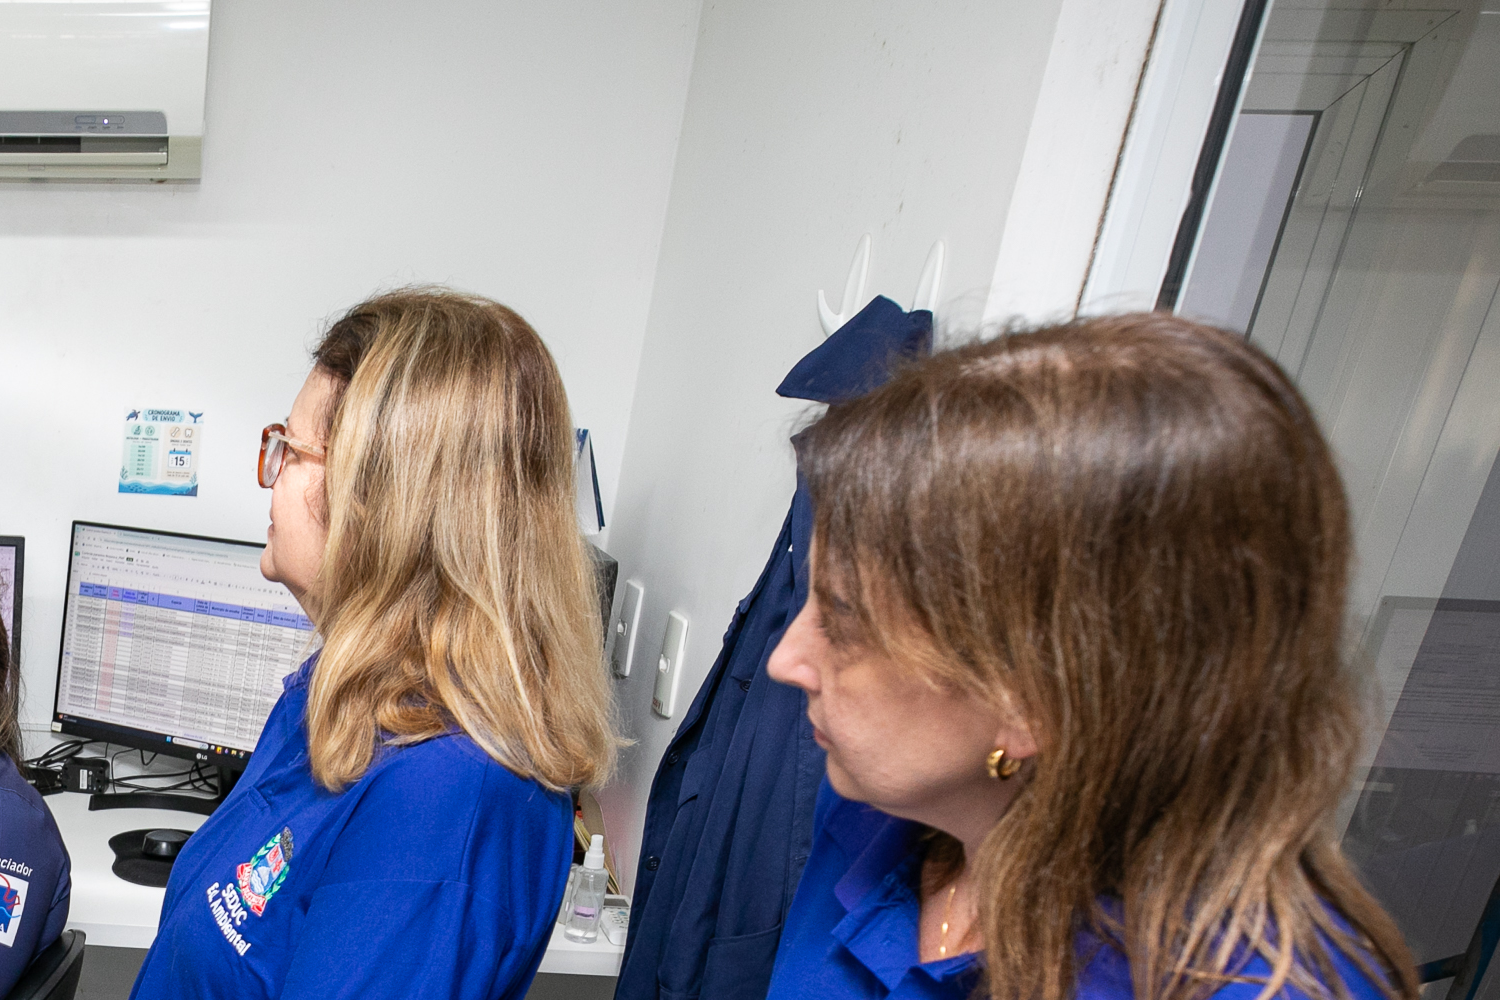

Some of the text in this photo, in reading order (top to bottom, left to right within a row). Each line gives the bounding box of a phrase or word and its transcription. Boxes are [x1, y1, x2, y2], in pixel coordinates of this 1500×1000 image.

[147, 409, 181, 417] CRONOGRAMA
[174, 456, 185, 467] 15
[221, 883, 248, 926] SEDUC
[209, 897, 252, 956] Ambiental
